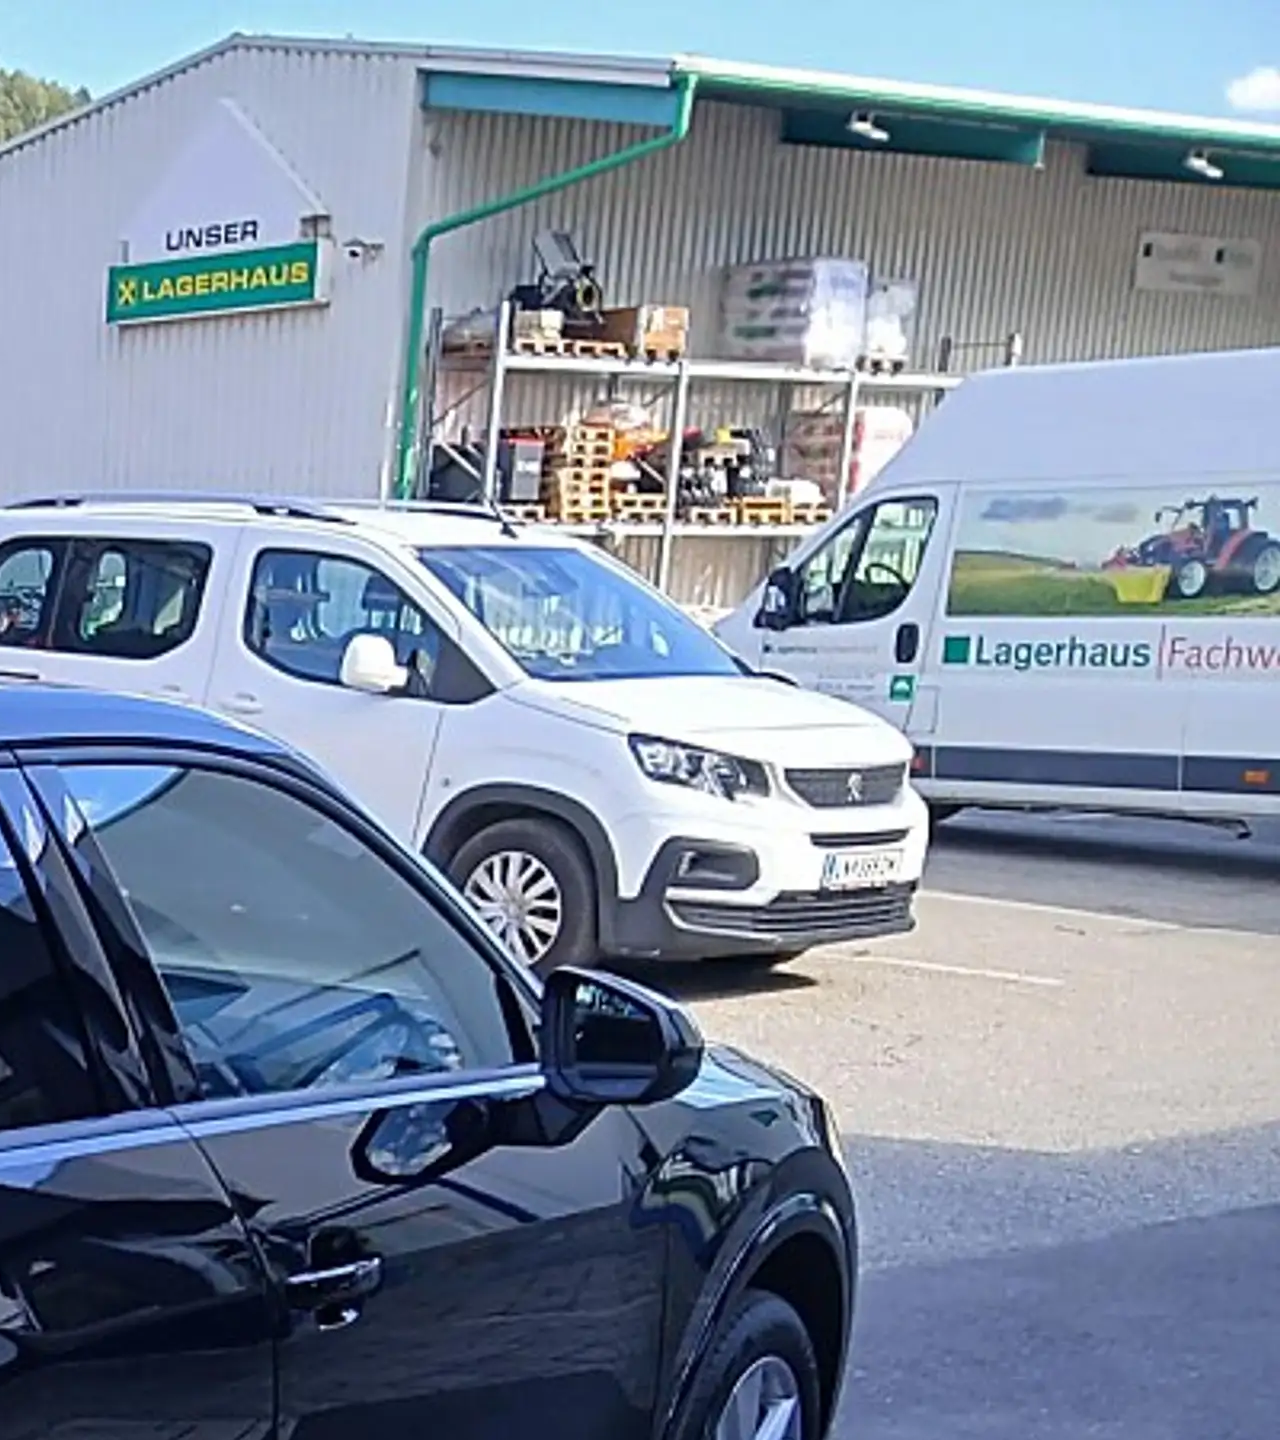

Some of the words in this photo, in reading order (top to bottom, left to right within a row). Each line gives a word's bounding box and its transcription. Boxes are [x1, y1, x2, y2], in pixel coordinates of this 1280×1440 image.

[166, 220, 258, 251] UNSER
[142, 262, 309, 301] LAGERHAUS
[976, 635, 1152, 671] Lagerhaus
[1168, 635, 1280, 670] Fachw
